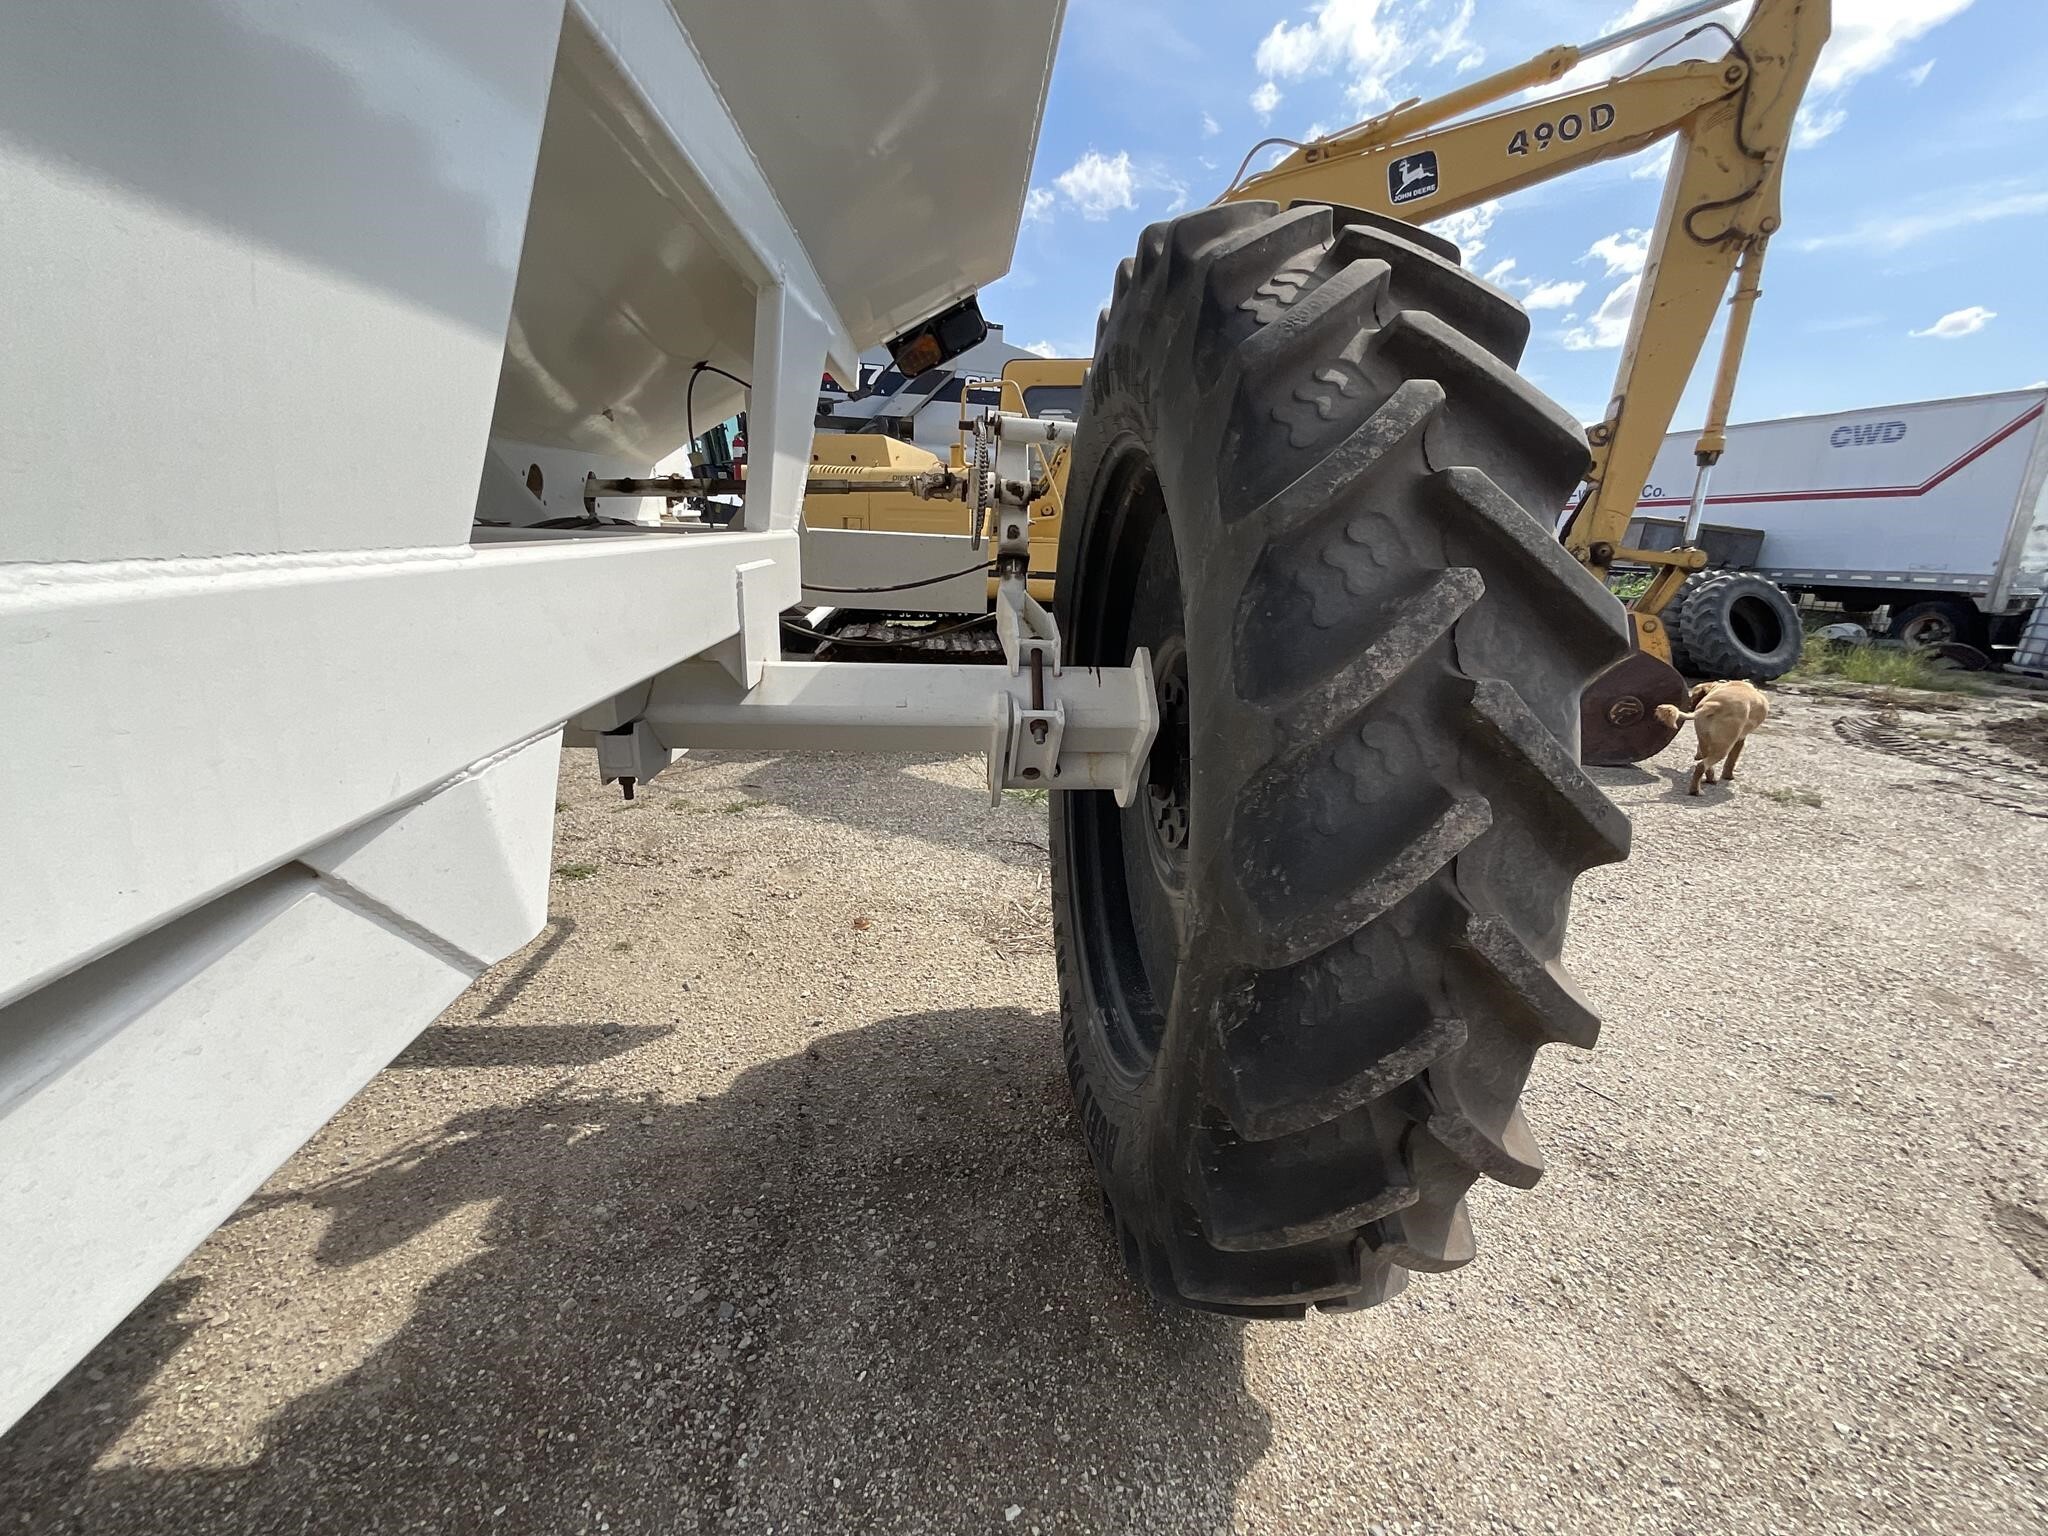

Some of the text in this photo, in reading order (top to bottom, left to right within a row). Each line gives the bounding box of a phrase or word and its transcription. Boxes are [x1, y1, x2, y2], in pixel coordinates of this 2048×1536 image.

[1507, 103, 1616, 156] 490D
[1394, 184, 1436, 202] JOHN DEERE
[1830, 421, 1907, 448] CWD
[1642, 484, 1666, 498] Co.
